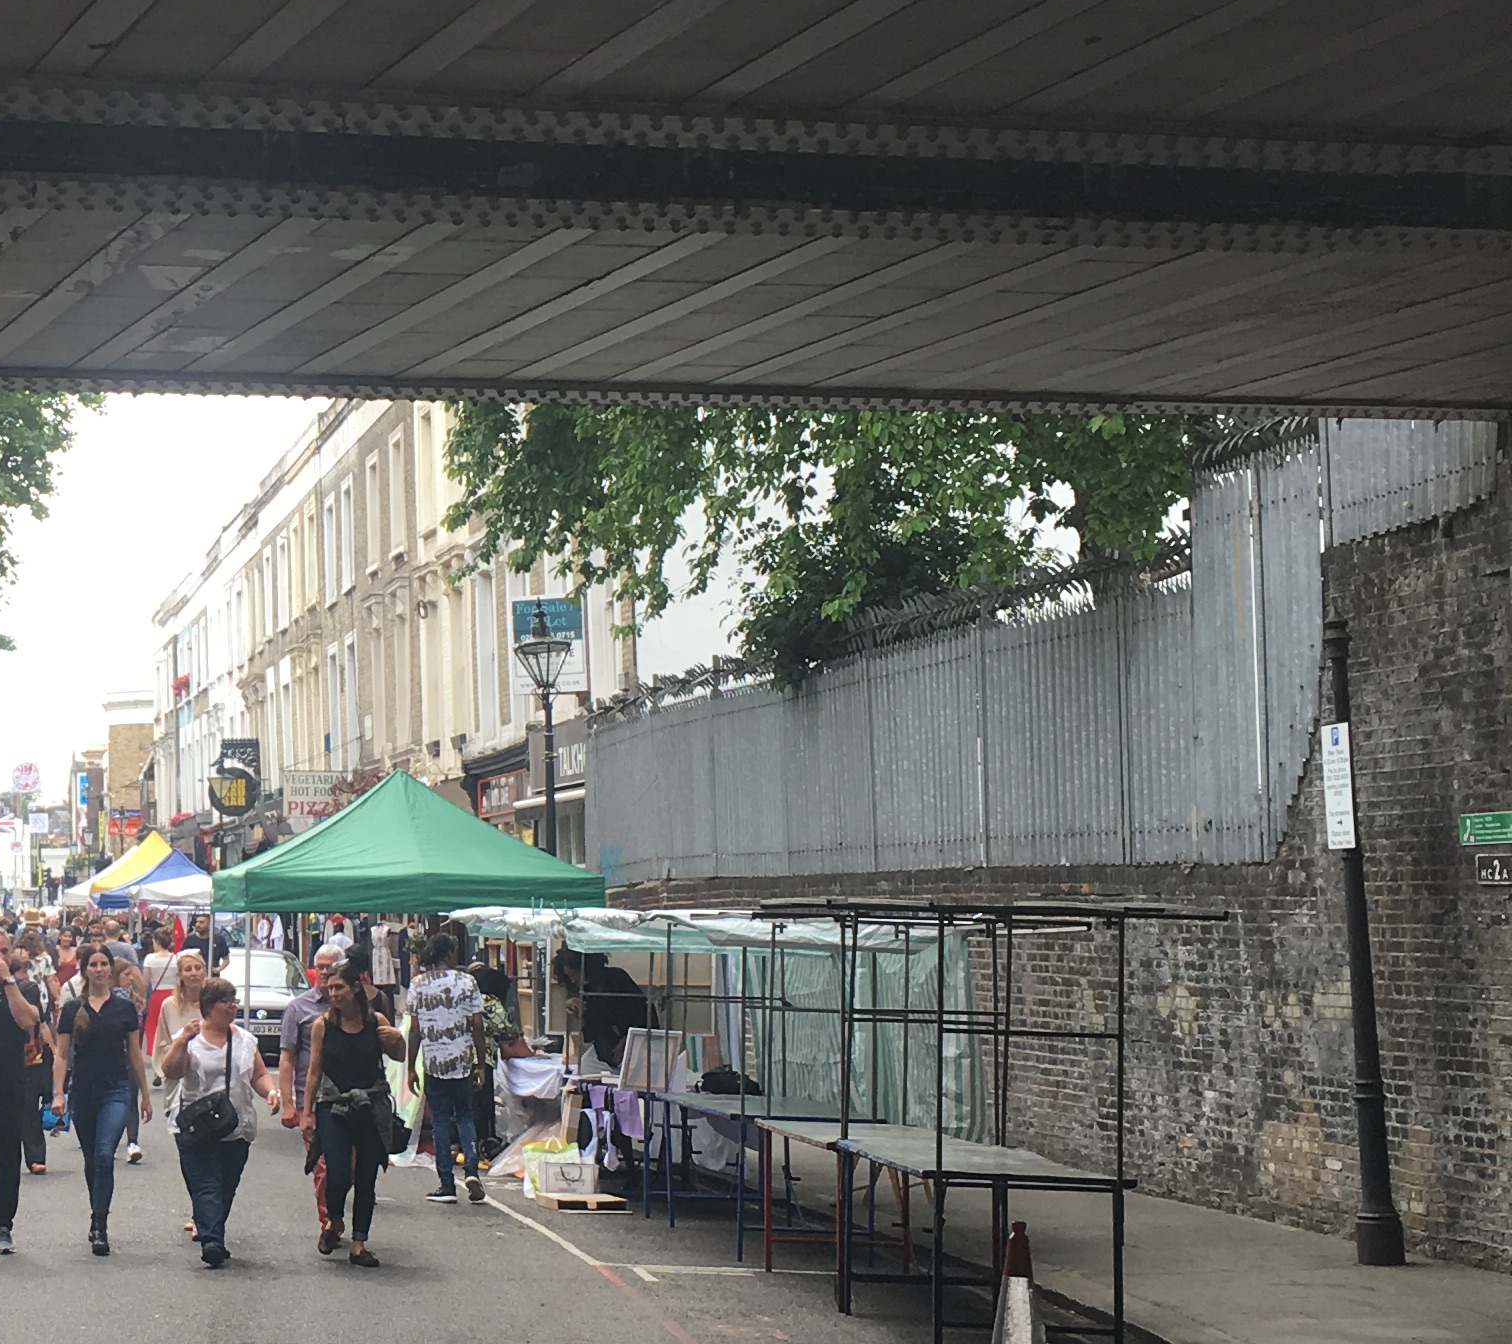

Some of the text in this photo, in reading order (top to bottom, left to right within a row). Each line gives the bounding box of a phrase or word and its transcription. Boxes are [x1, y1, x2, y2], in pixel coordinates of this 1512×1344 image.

[541, 600, 566, 613] Sale
[290, 786, 310, 797] HOT
[252, 1025, 266, 1034] J03
